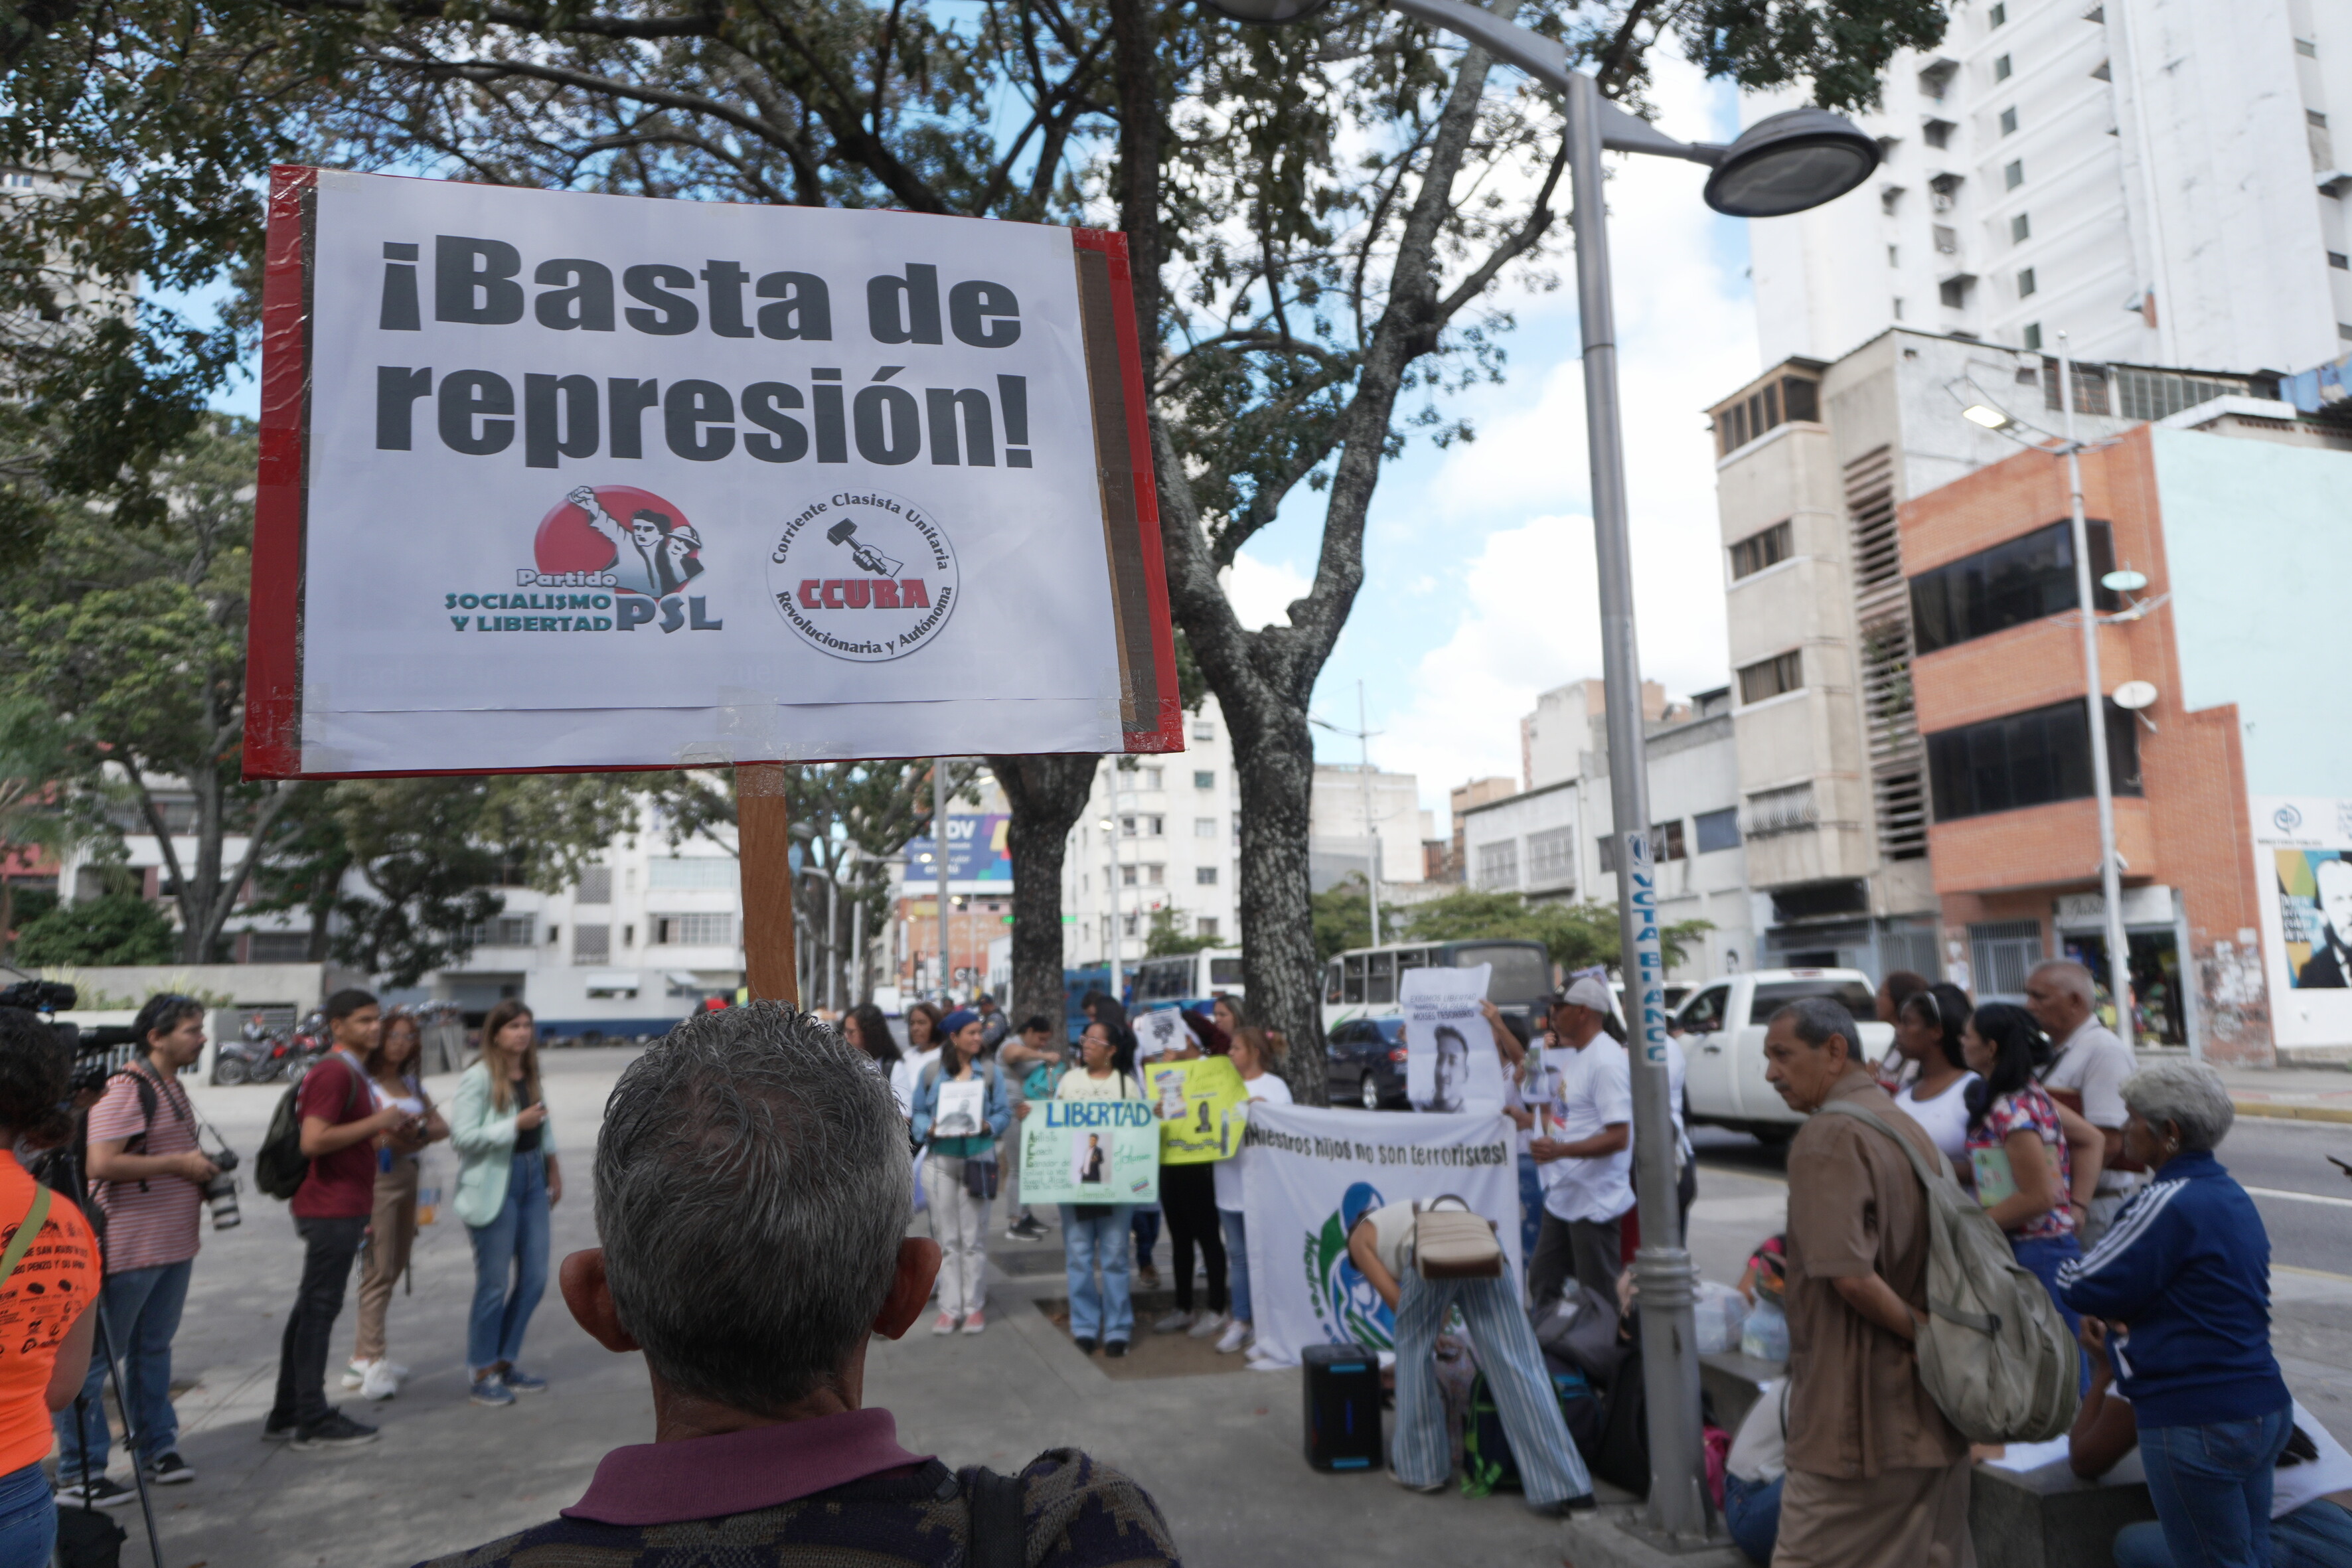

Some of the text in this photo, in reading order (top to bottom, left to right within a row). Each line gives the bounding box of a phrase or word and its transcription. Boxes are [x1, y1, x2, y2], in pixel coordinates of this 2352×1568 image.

[380, 235, 1020, 348] ¡Basta de
[376, 366, 1032, 469] represión!
[772, 493, 949, 570] Corriente Clasista Unitaria
[516, 569, 617, 588] Partido
[797, 578, 931, 609] CCURA
[444, 593, 611, 610] SOCIALISMO
[616, 594, 722, 634] PSL
[450, 615, 611, 631] Y LIBERTAD
[776, 586, 951, 655] Revolucionaria y Autónoma
[1444, 993, 1476, 1002] LIBERTAD
[1046, 1102, 1151, 1128] LIBERTAD
[1314, 1136, 1352, 1161] hijos
[1355, 1143, 1373, 1163] no
[1378, 1144, 1407, 1164] son
[1411, 1141, 1508, 1166] terroristas!
[37, 1245, 52, 1255] SAN
[1304, 1230, 1324, 1319] Madres
